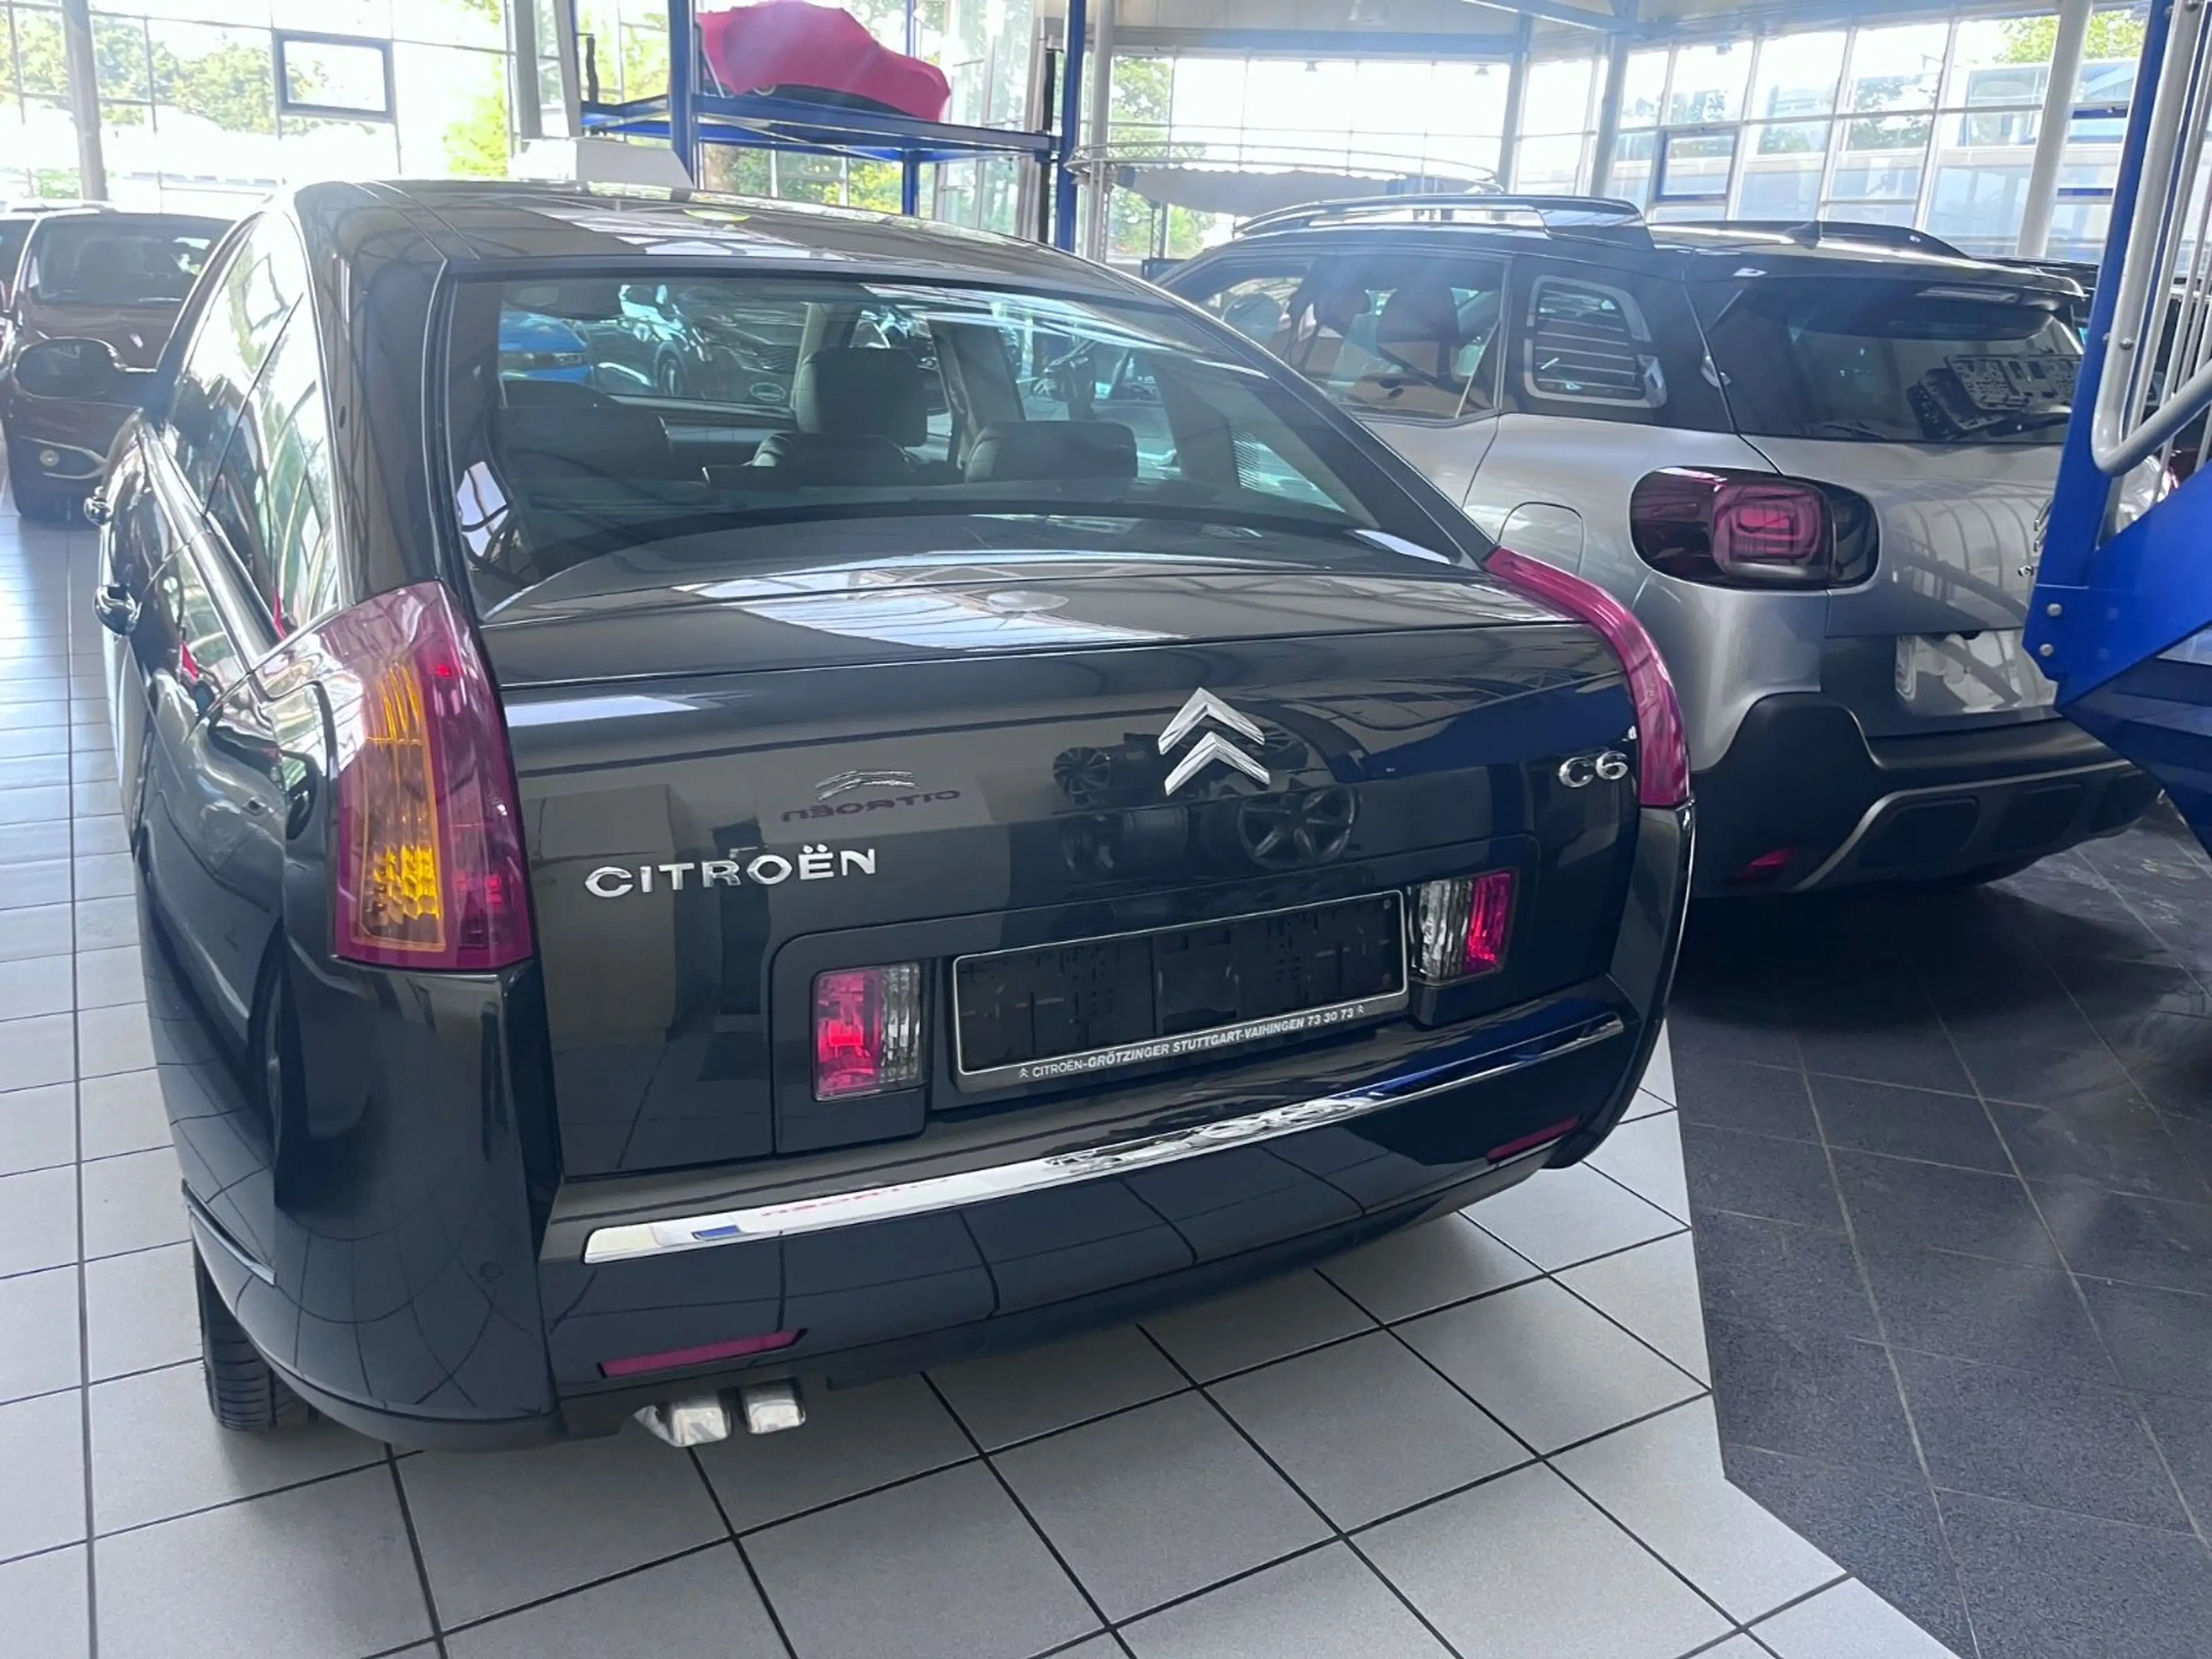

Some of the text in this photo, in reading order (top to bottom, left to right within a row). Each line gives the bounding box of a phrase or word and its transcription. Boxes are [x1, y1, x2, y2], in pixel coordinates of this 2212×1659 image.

[1558, 750, 1628, 787] C6
[585, 843, 877, 898] CITROËN
[1032, 1007, 1354, 1078] CITROËN-GRÖTZINGER STUTTGART-VAIHINGEN 73 30 73
